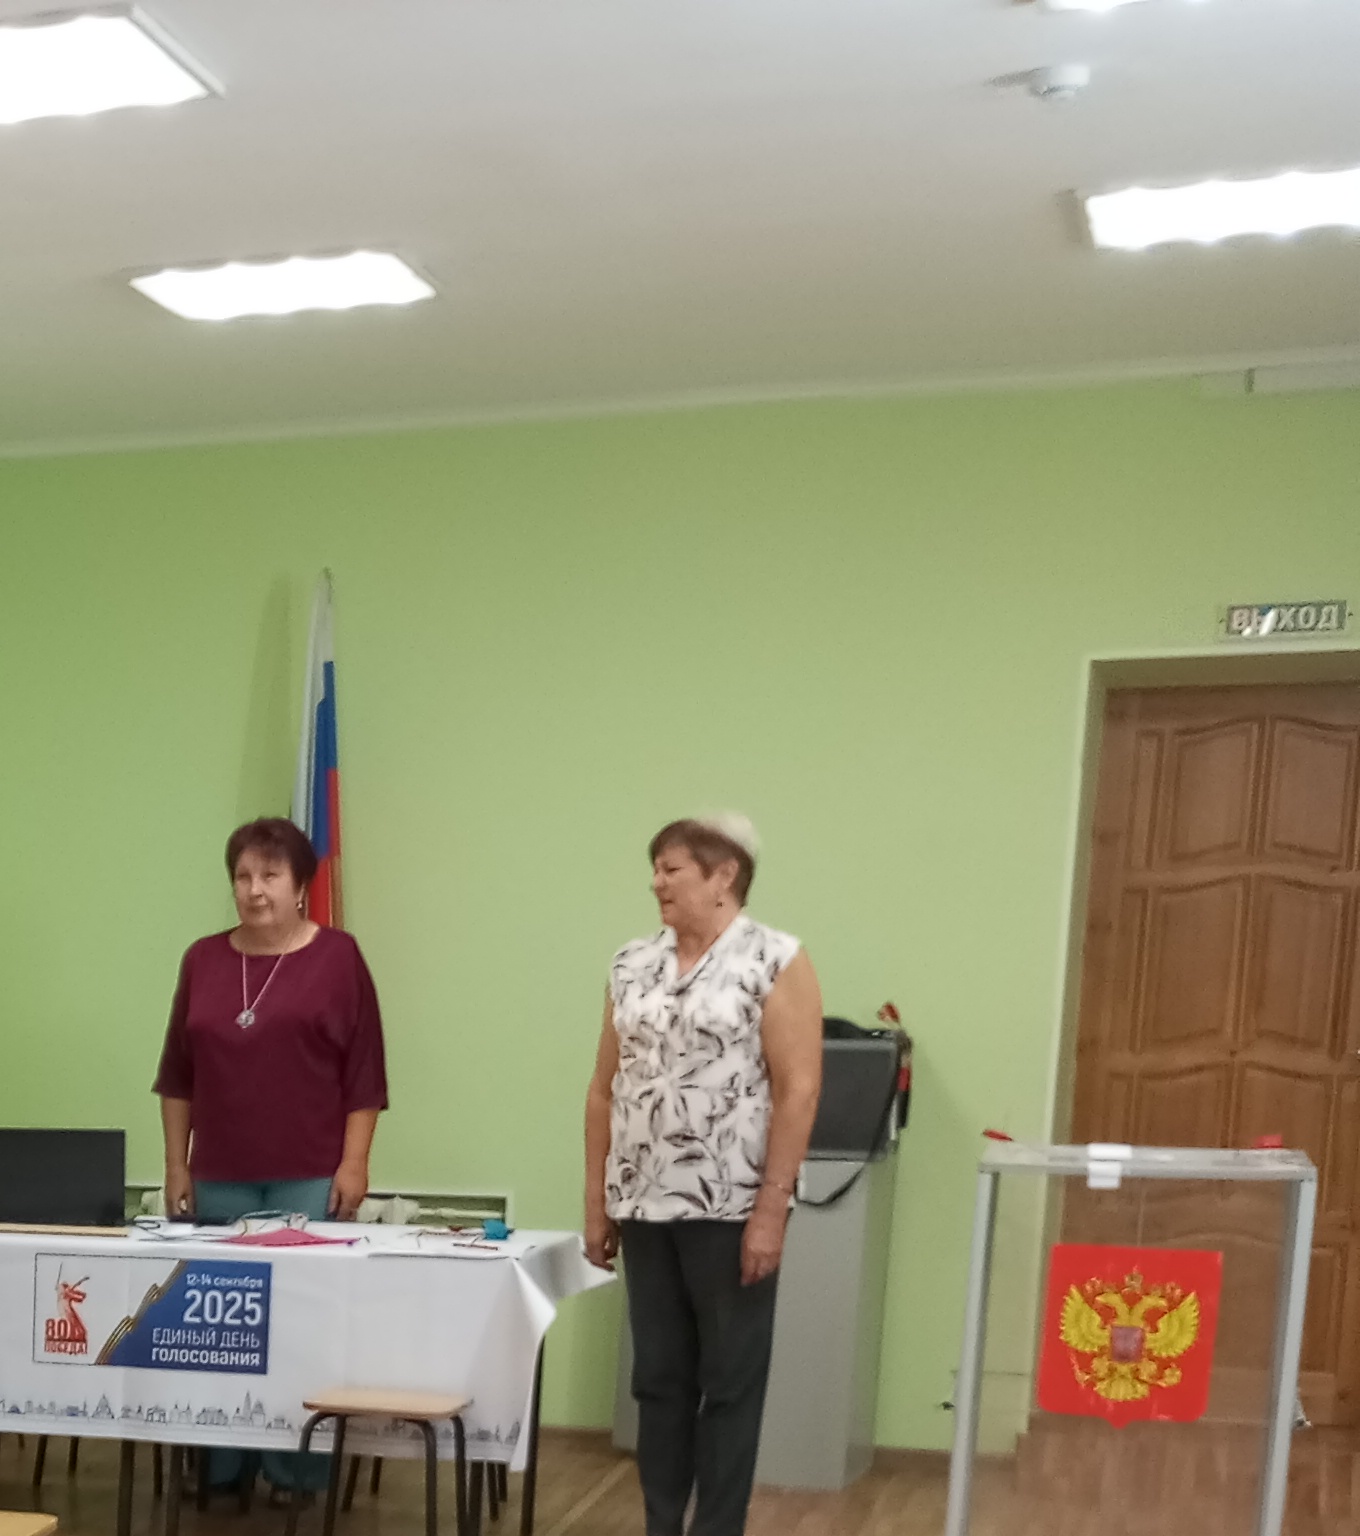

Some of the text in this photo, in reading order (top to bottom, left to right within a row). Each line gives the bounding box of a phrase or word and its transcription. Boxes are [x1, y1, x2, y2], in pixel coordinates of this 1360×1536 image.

[183, 1289, 262, 1325] 2025
[152, 1326, 260, 1348] ЕДИНЫЙ ДЕНЬ
